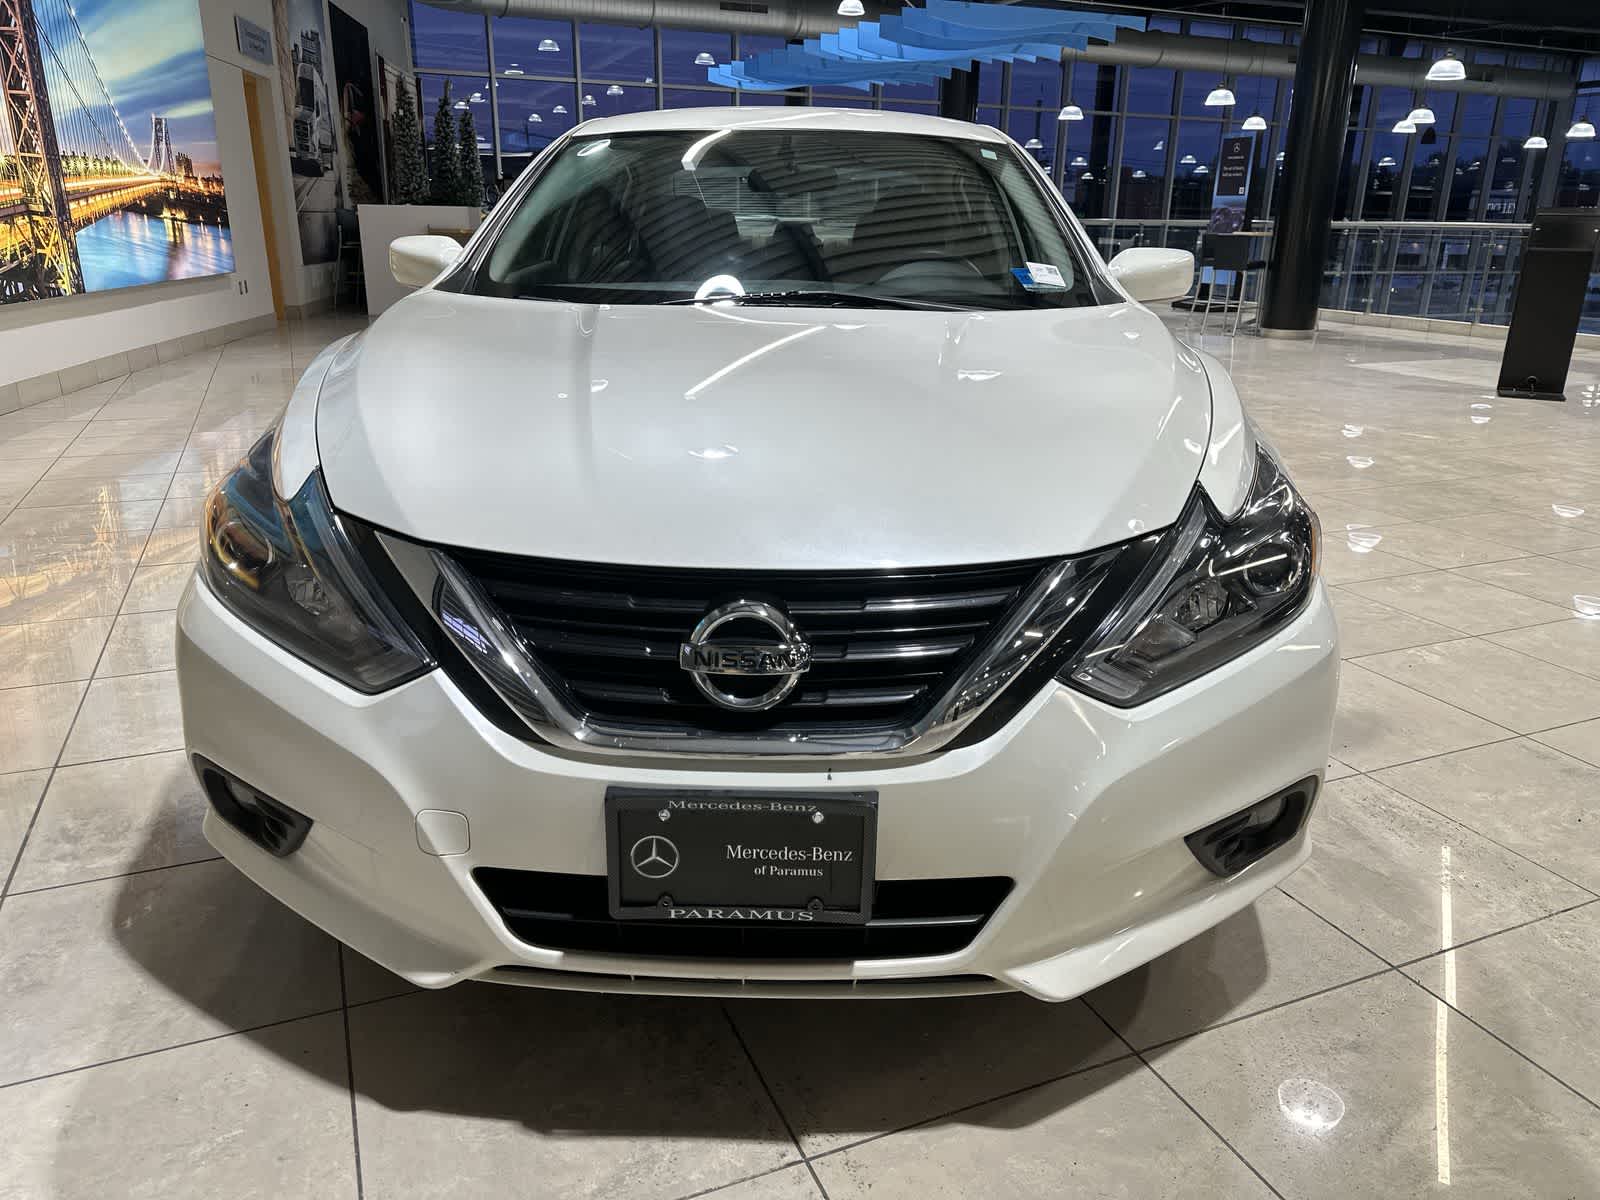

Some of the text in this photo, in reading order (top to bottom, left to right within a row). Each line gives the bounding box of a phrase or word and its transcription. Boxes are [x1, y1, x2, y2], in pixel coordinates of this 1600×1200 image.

[694, 650, 796, 669] NISSAN
[668, 800, 818, 812] Mercedes-Benz
[726, 844, 853, 862] Mercedes-Benz
[754, 865, 824, 877] of Paramus
[669, 908, 814, 921] PARAMUS
